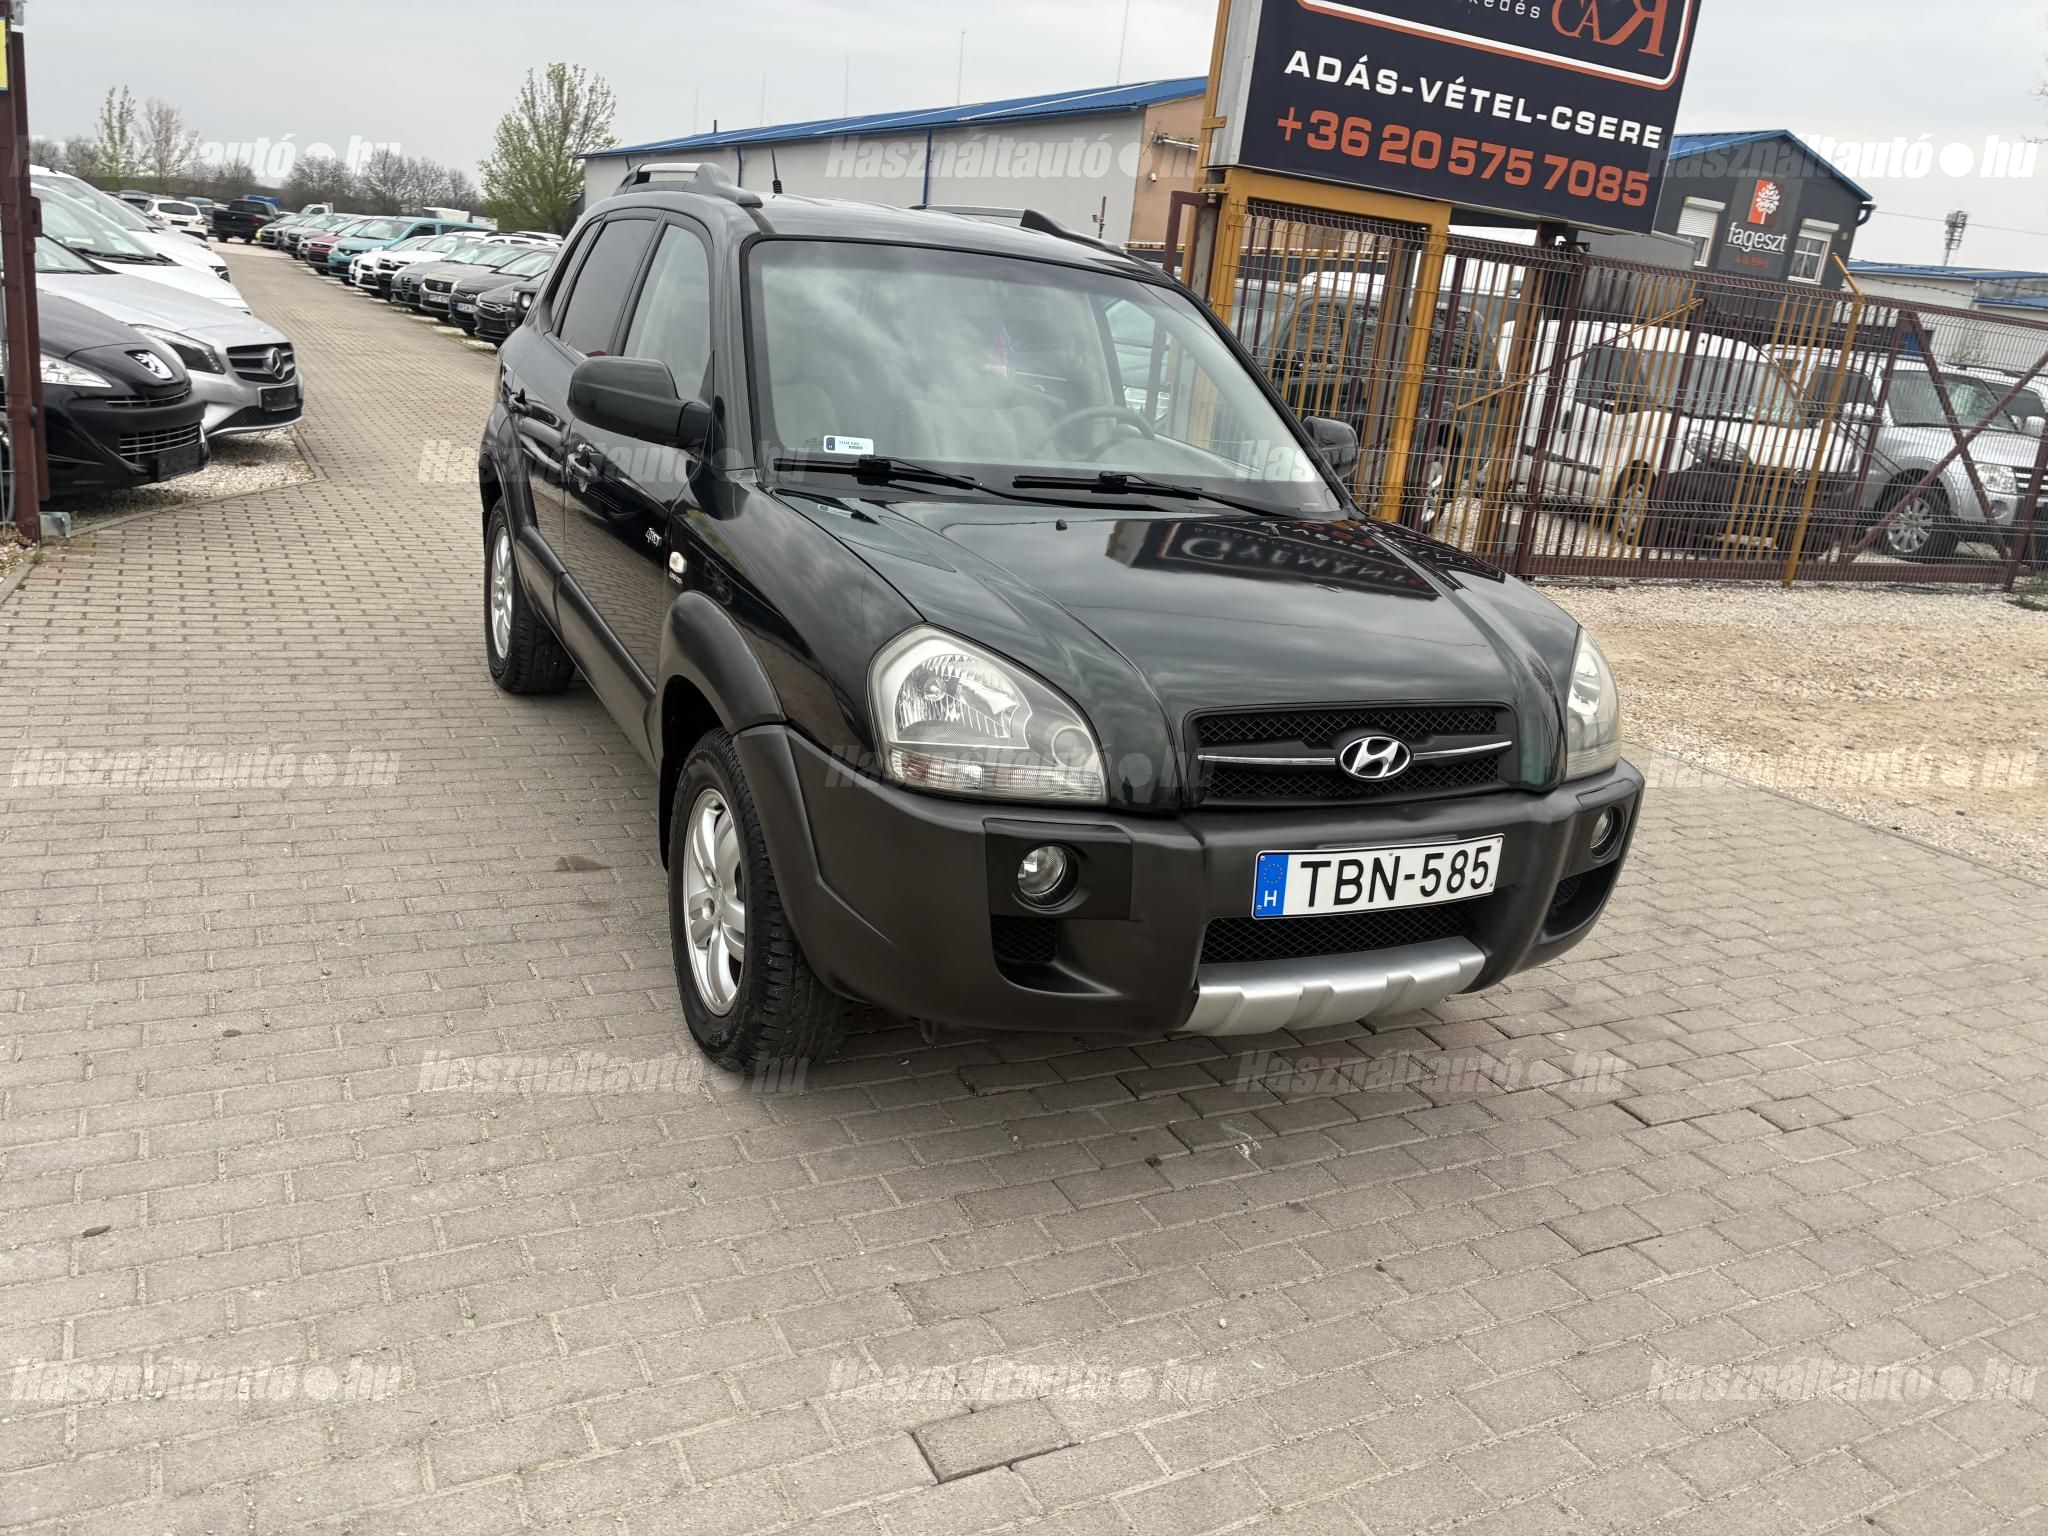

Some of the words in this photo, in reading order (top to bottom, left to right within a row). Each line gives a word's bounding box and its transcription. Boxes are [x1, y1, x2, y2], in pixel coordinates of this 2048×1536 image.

[1469, 0, 1540, 19] edés
[1283, 50, 1663, 149] ADÁS-VÉTEL-CSERE
[1276, 106, 1372, 158] +36
[1378, 124, 1442, 170] 20
[1448, 138, 1534, 186] 575
[1543, 154, 1650, 207] 7085
[1727, 221, 1788, 253] fageszt
[1263, 890, 1277, 907] H
[1300, 845, 1492, 908] TBN-585
